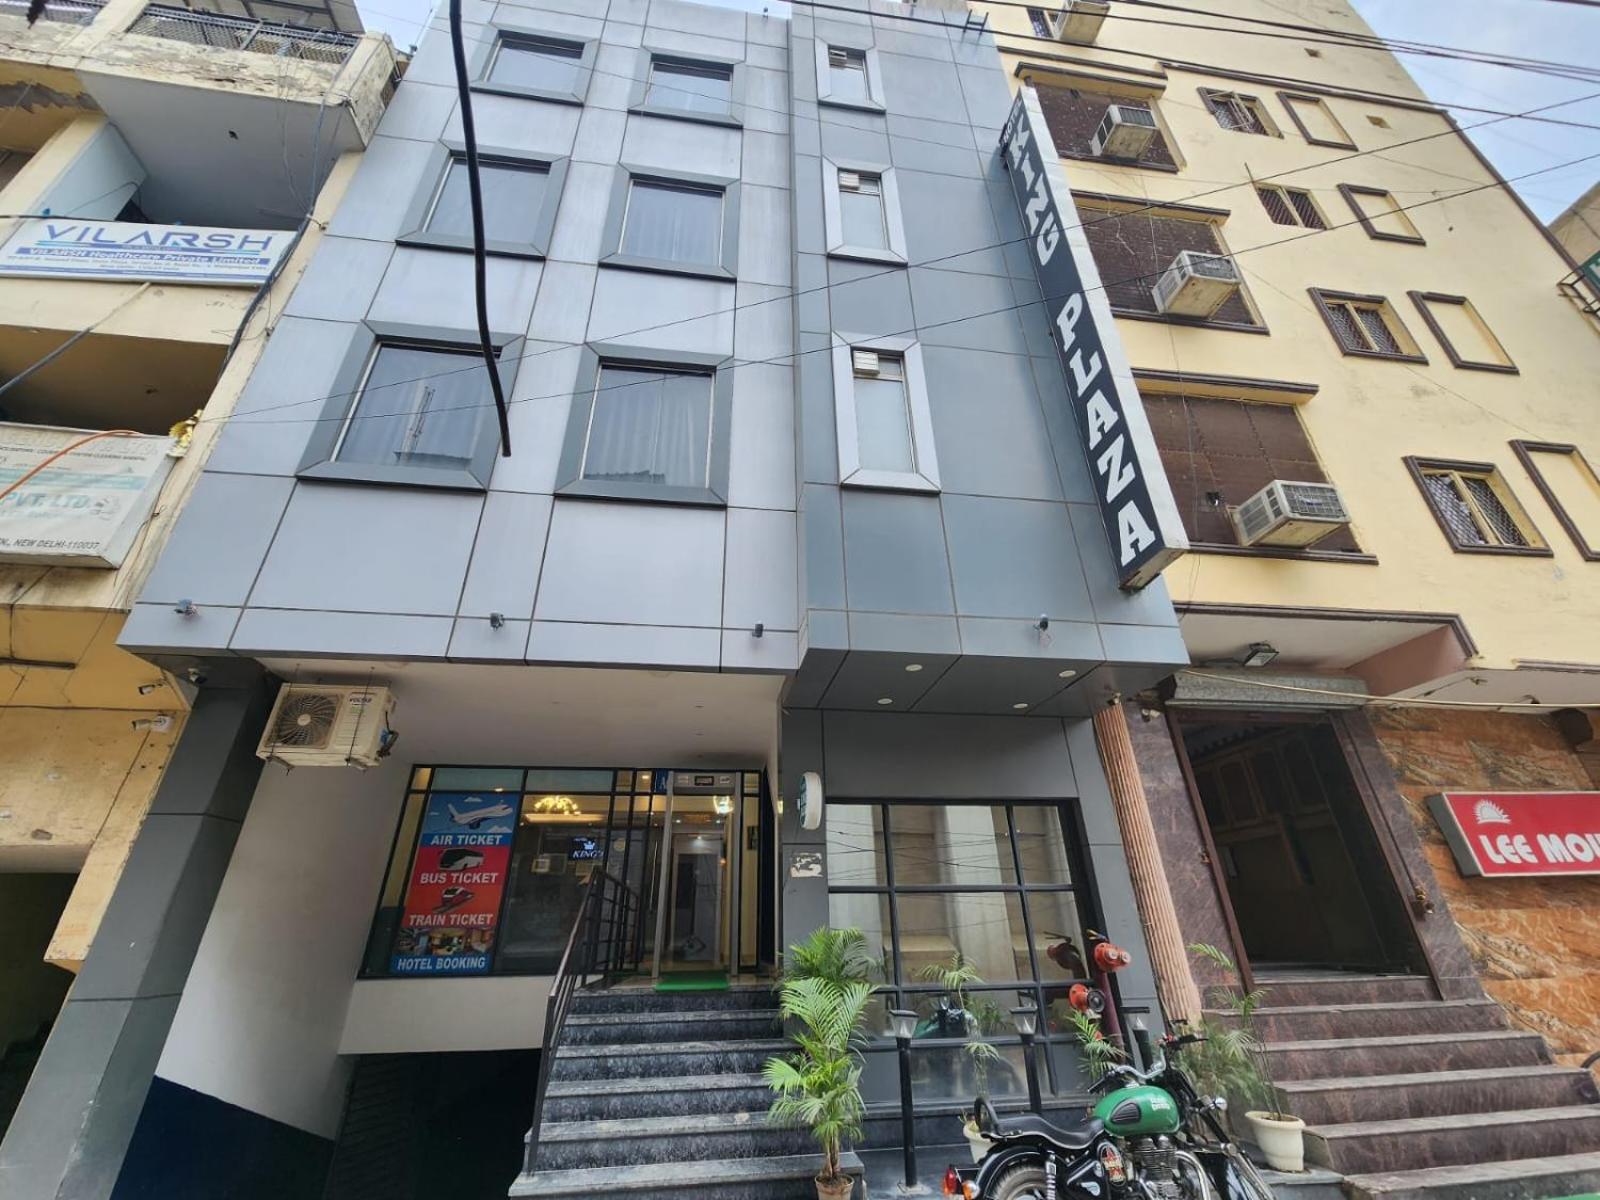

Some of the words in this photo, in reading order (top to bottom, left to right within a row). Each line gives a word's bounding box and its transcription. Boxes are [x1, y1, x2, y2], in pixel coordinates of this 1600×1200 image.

[47, 223, 273, 252] VILARSH
[89, 250, 160, 262] Healthcare
[163, 253, 209, 265] Private
[212, 256, 260, 266] Limited
[1009, 113, 1060, 267] KING
[1056, 292, 1156, 567] PLAZA
[15, 538, 37, 548] NEW
[430, 834, 453, 846] AIR
[457, 834, 503, 846] TICKET
[1478, 834, 1539, 864] LEE
[420, 872, 447, 884] BUS
[450, 872, 499, 884] TICKET
[409, 914, 446, 926] TRAIN
[449, 913, 494, 926] TICKET
[397, 957, 433, 971] HOTEL
[435, 956, 486, 970] BOOKING
